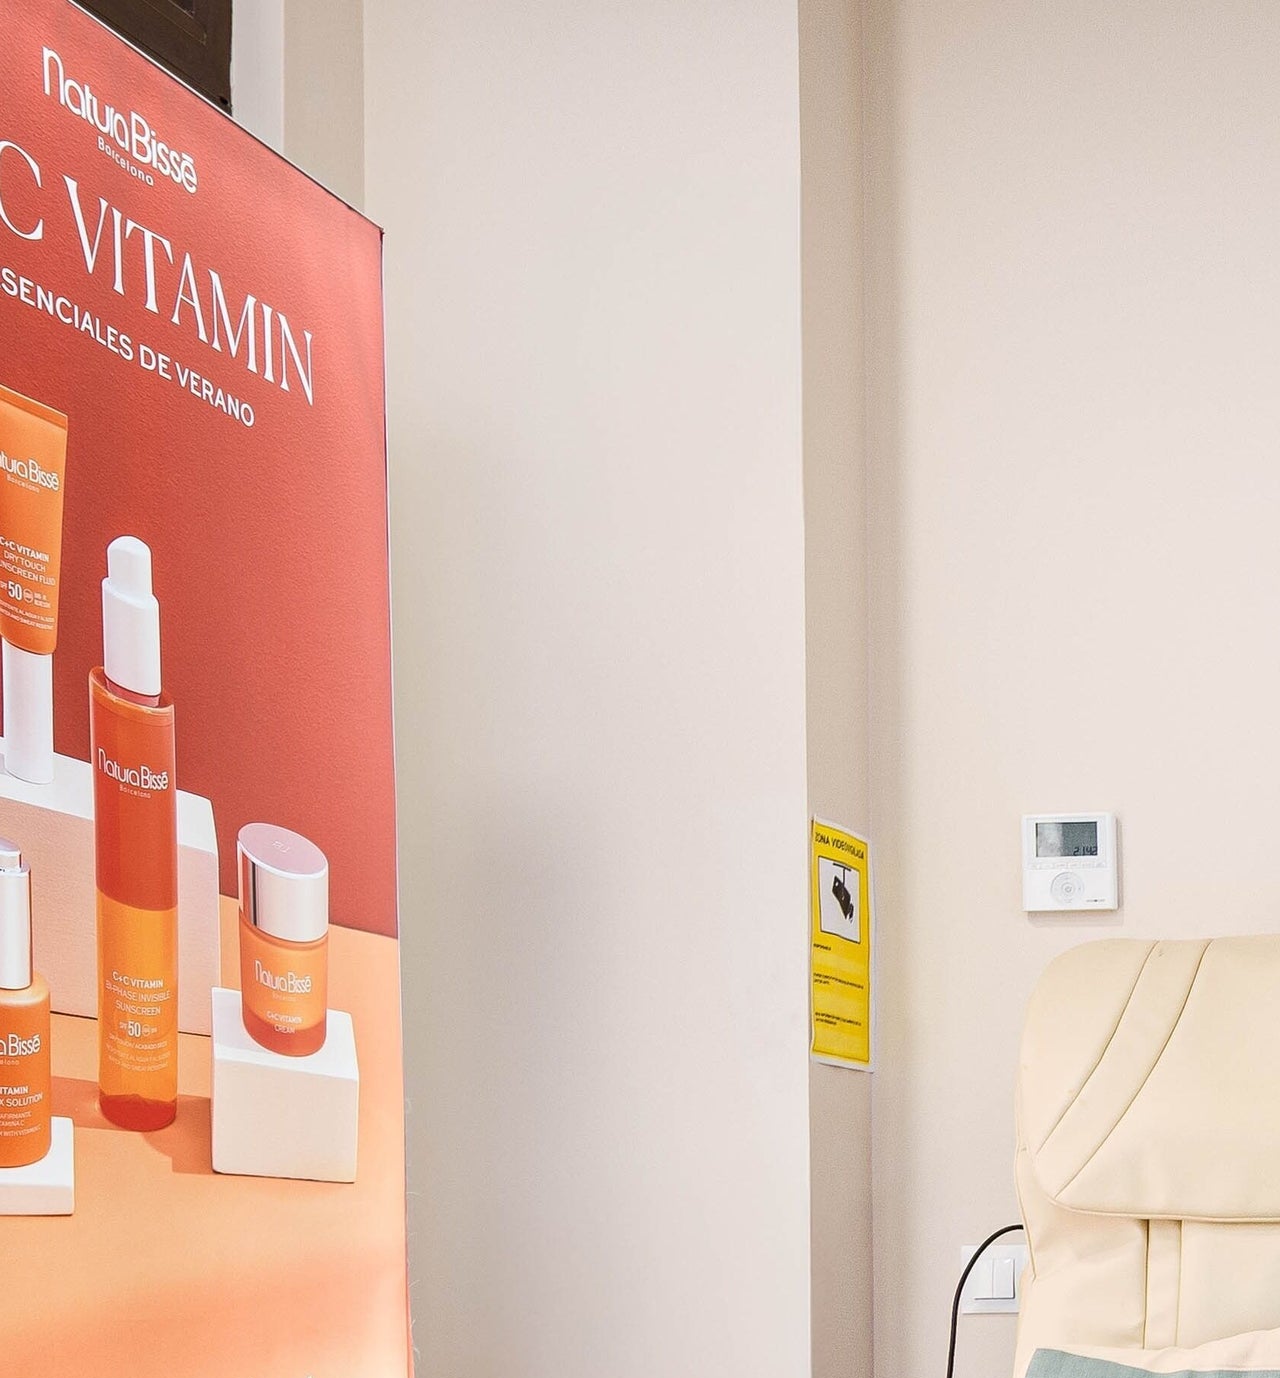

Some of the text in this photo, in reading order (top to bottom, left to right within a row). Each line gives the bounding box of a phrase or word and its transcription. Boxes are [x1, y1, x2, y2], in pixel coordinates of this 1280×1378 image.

[97, 135, 154, 187] Barcelona
[0, 140, 313, 407] C VITAMIN
[139, 343, 172, 381] DE
[174, 361, 256, 427] VERANO
[16, 544, 50, 563] VITAMIN
[20, 557, 46, 573] TOUCH
[8, 580, 23, 600] 50
[112, 971, 164, 990] C+C VITAMIN
[138, 990, 171, 1003] INVISIBLE
[115, 999, 161, 1016] SUNSCREEN
[128, 1021, 141, 1038] 50
[6, 1092, 43, 1108] SOLUTION
